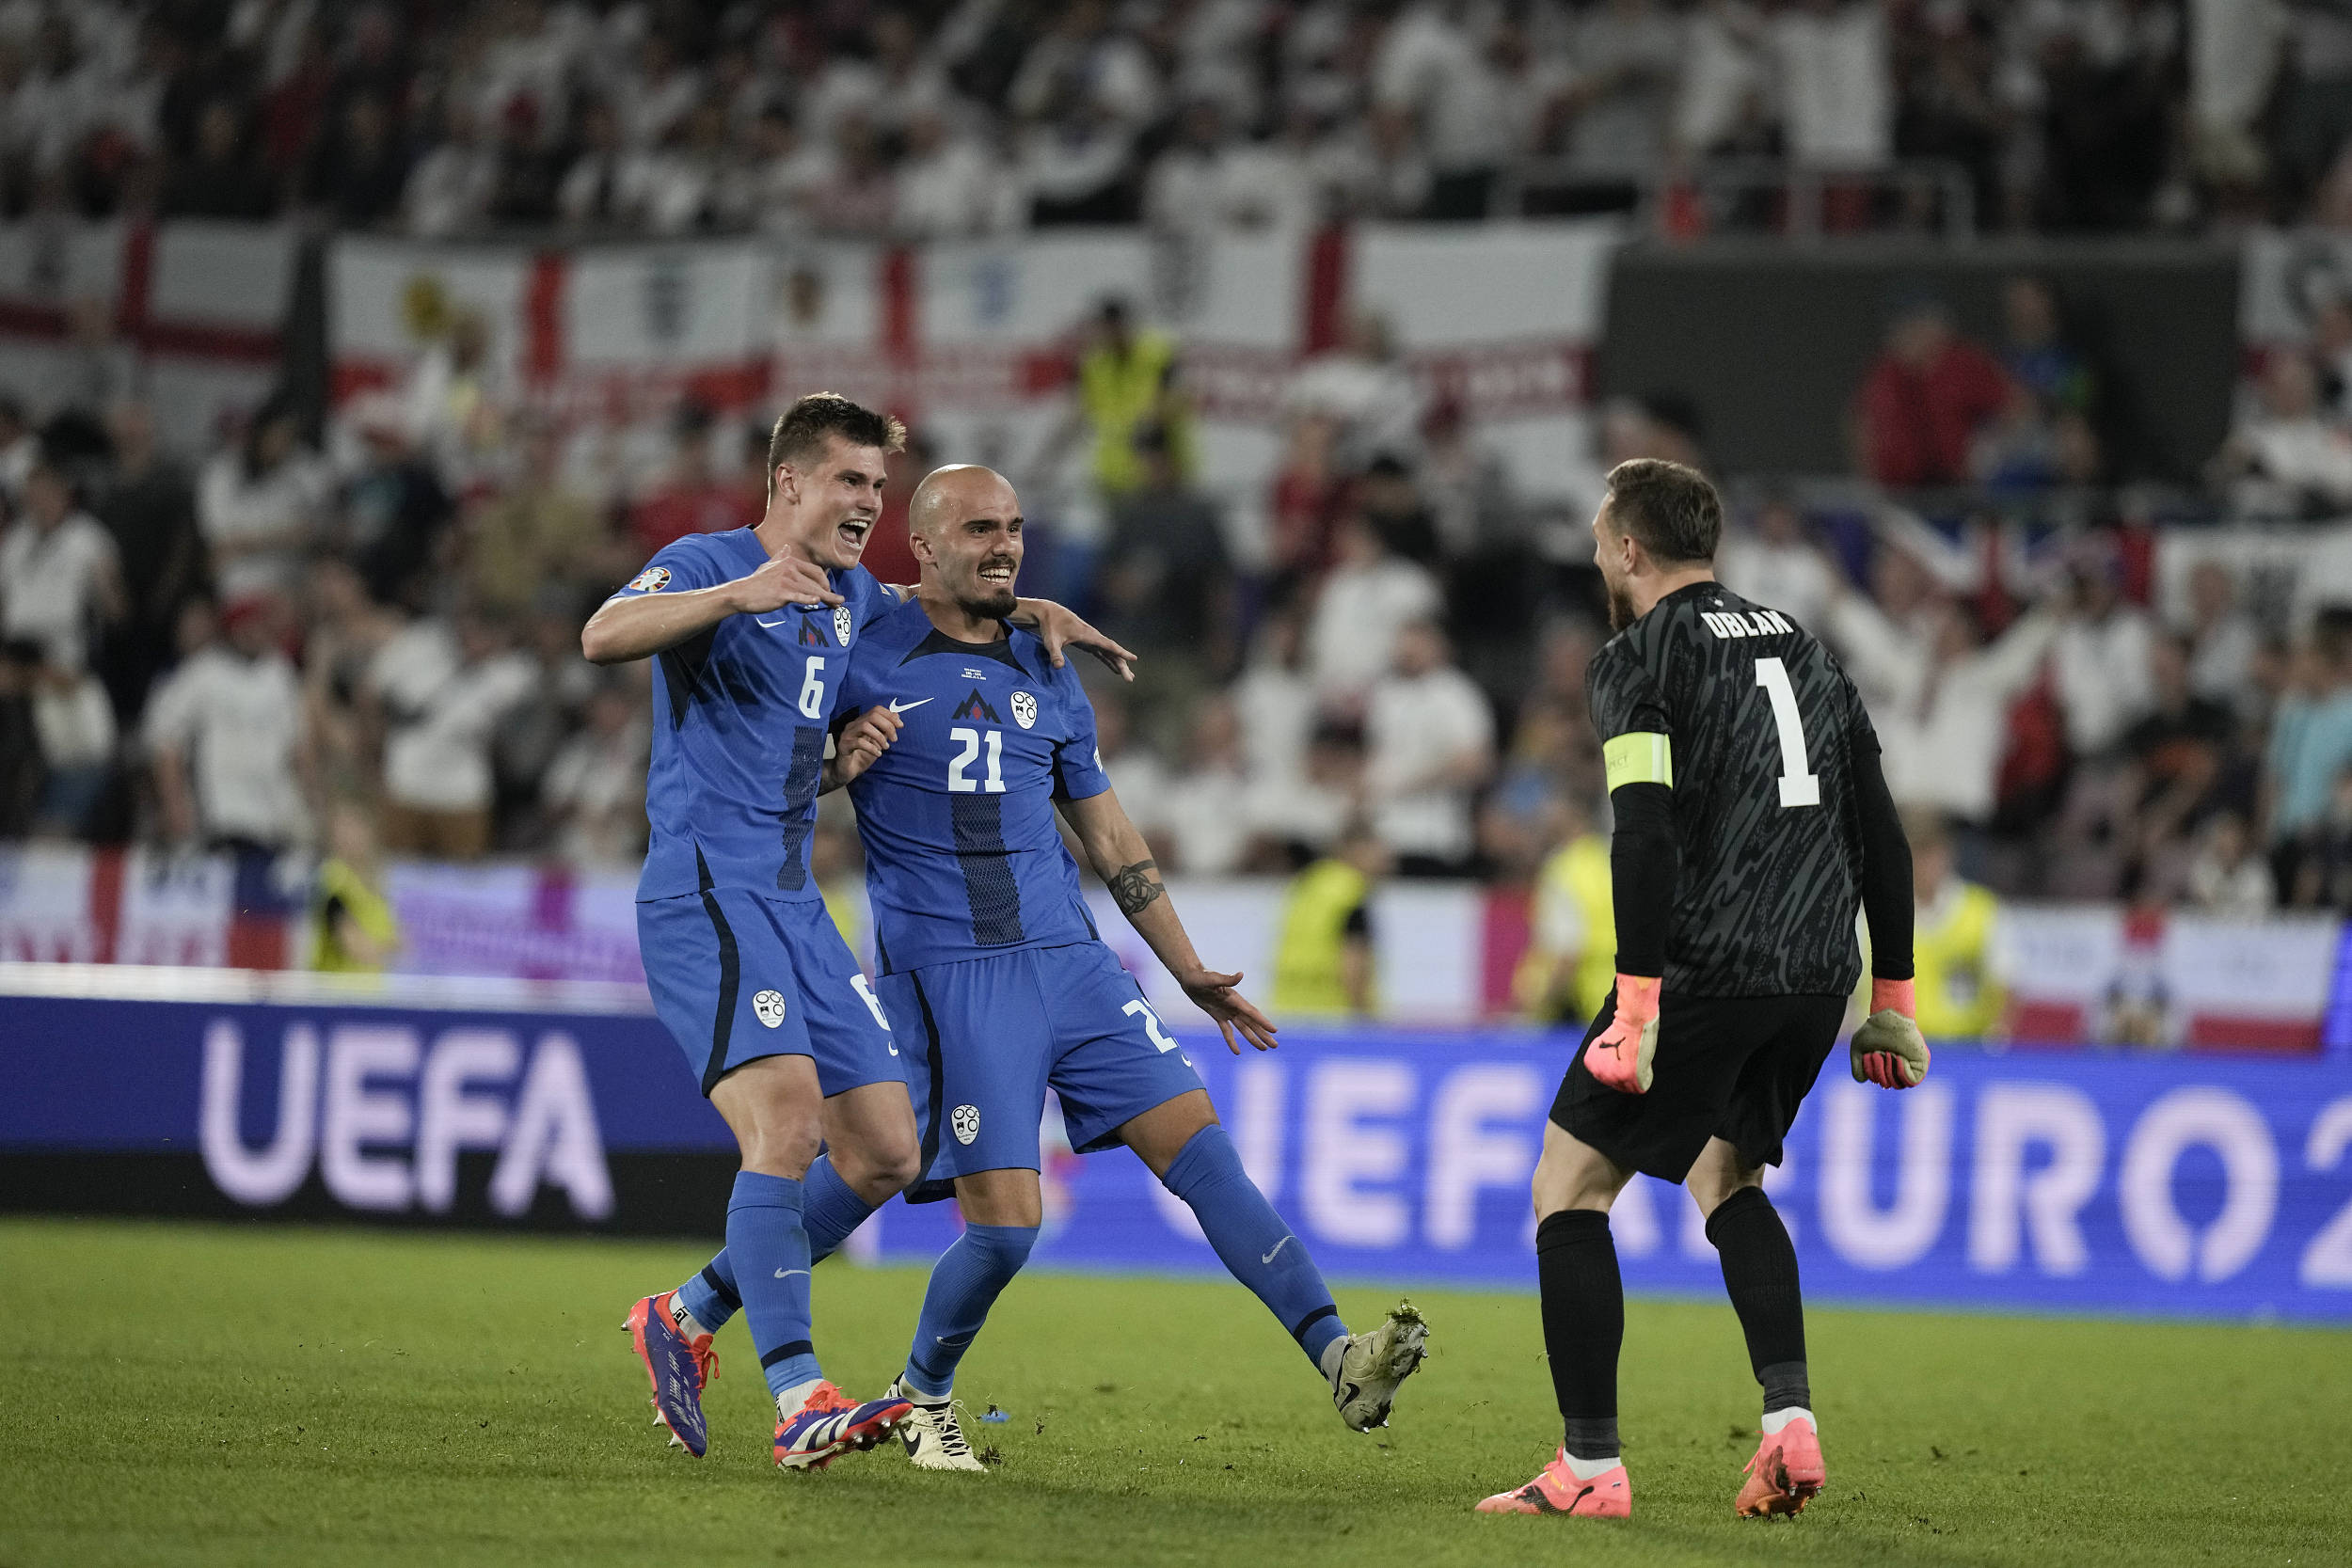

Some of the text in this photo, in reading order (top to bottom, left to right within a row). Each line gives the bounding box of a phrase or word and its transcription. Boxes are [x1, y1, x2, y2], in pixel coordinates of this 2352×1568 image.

[799, 656, 824, 719] 6
[1755, 657, 1820, 807] 1
[948, 727, 1007, 792] 21
[1121, 997, 1181, 1053] 2
[200, 1020, 616, 1220] UEFA
[1147, 1057, 1663, 1262] UEF
[1679, 1076, 2280, 1285] URO
